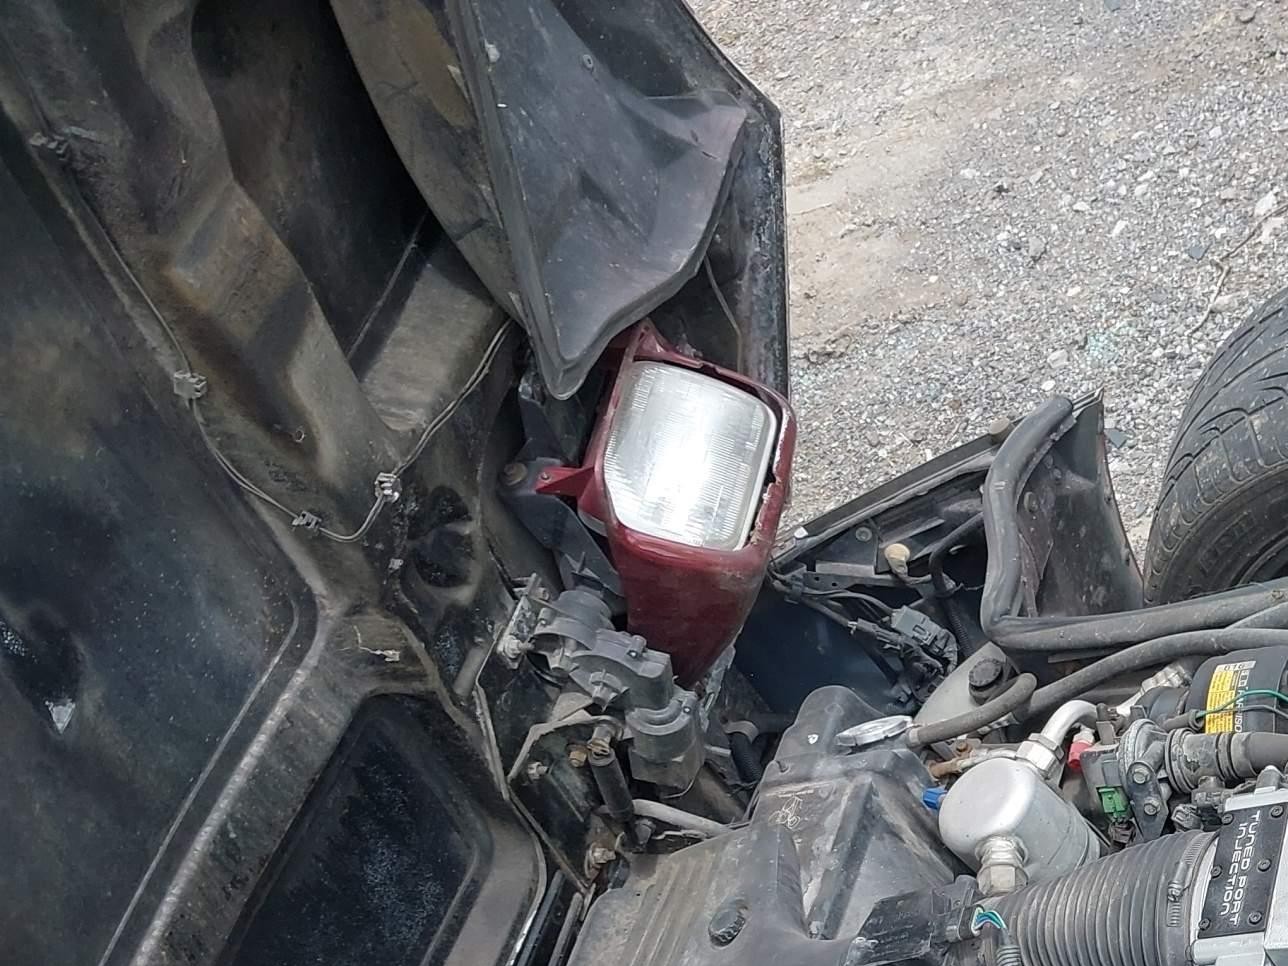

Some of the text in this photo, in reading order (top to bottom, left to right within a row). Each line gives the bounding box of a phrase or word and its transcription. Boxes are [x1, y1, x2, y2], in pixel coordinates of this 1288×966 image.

[1219, 822, 1247, 917] INJECTION
[1229, 809, 1261, 926] TUNED PORT
